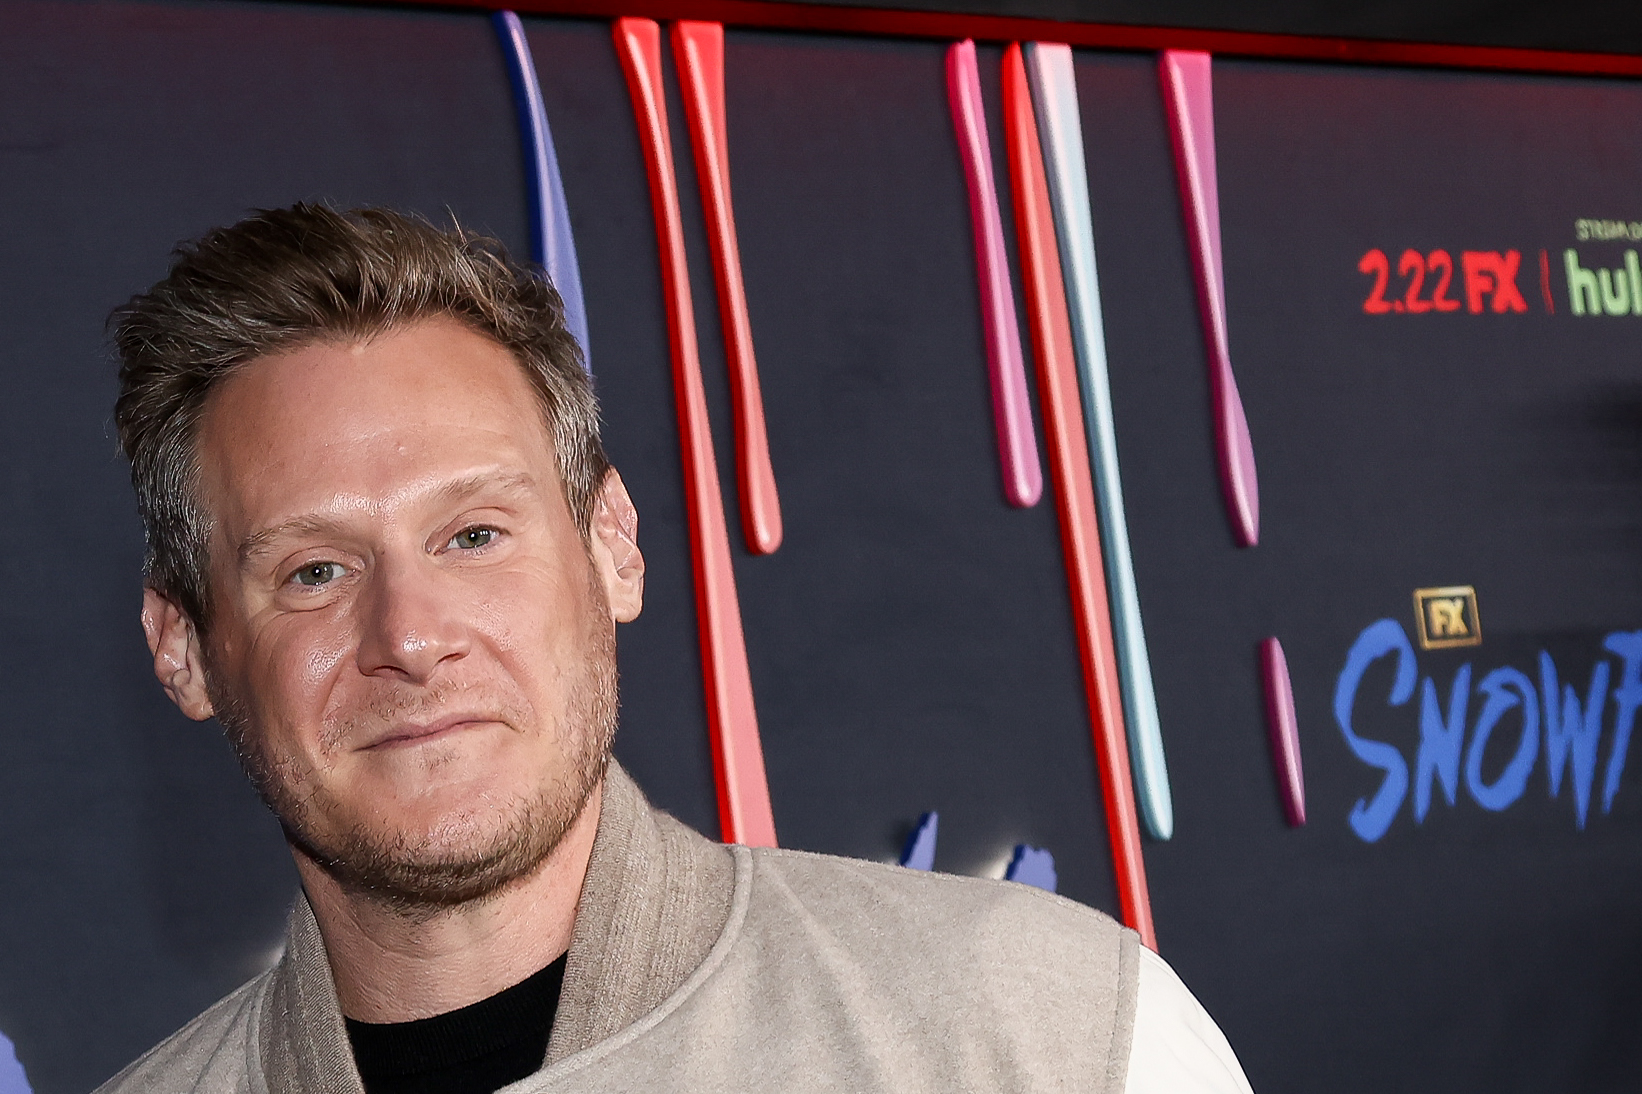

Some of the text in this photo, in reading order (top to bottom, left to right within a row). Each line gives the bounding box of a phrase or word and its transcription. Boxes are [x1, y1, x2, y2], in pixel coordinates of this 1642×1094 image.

[1357, 247, 1642, 316] 2.22 FX hul
[1429, 599, 1469, 635] FX
